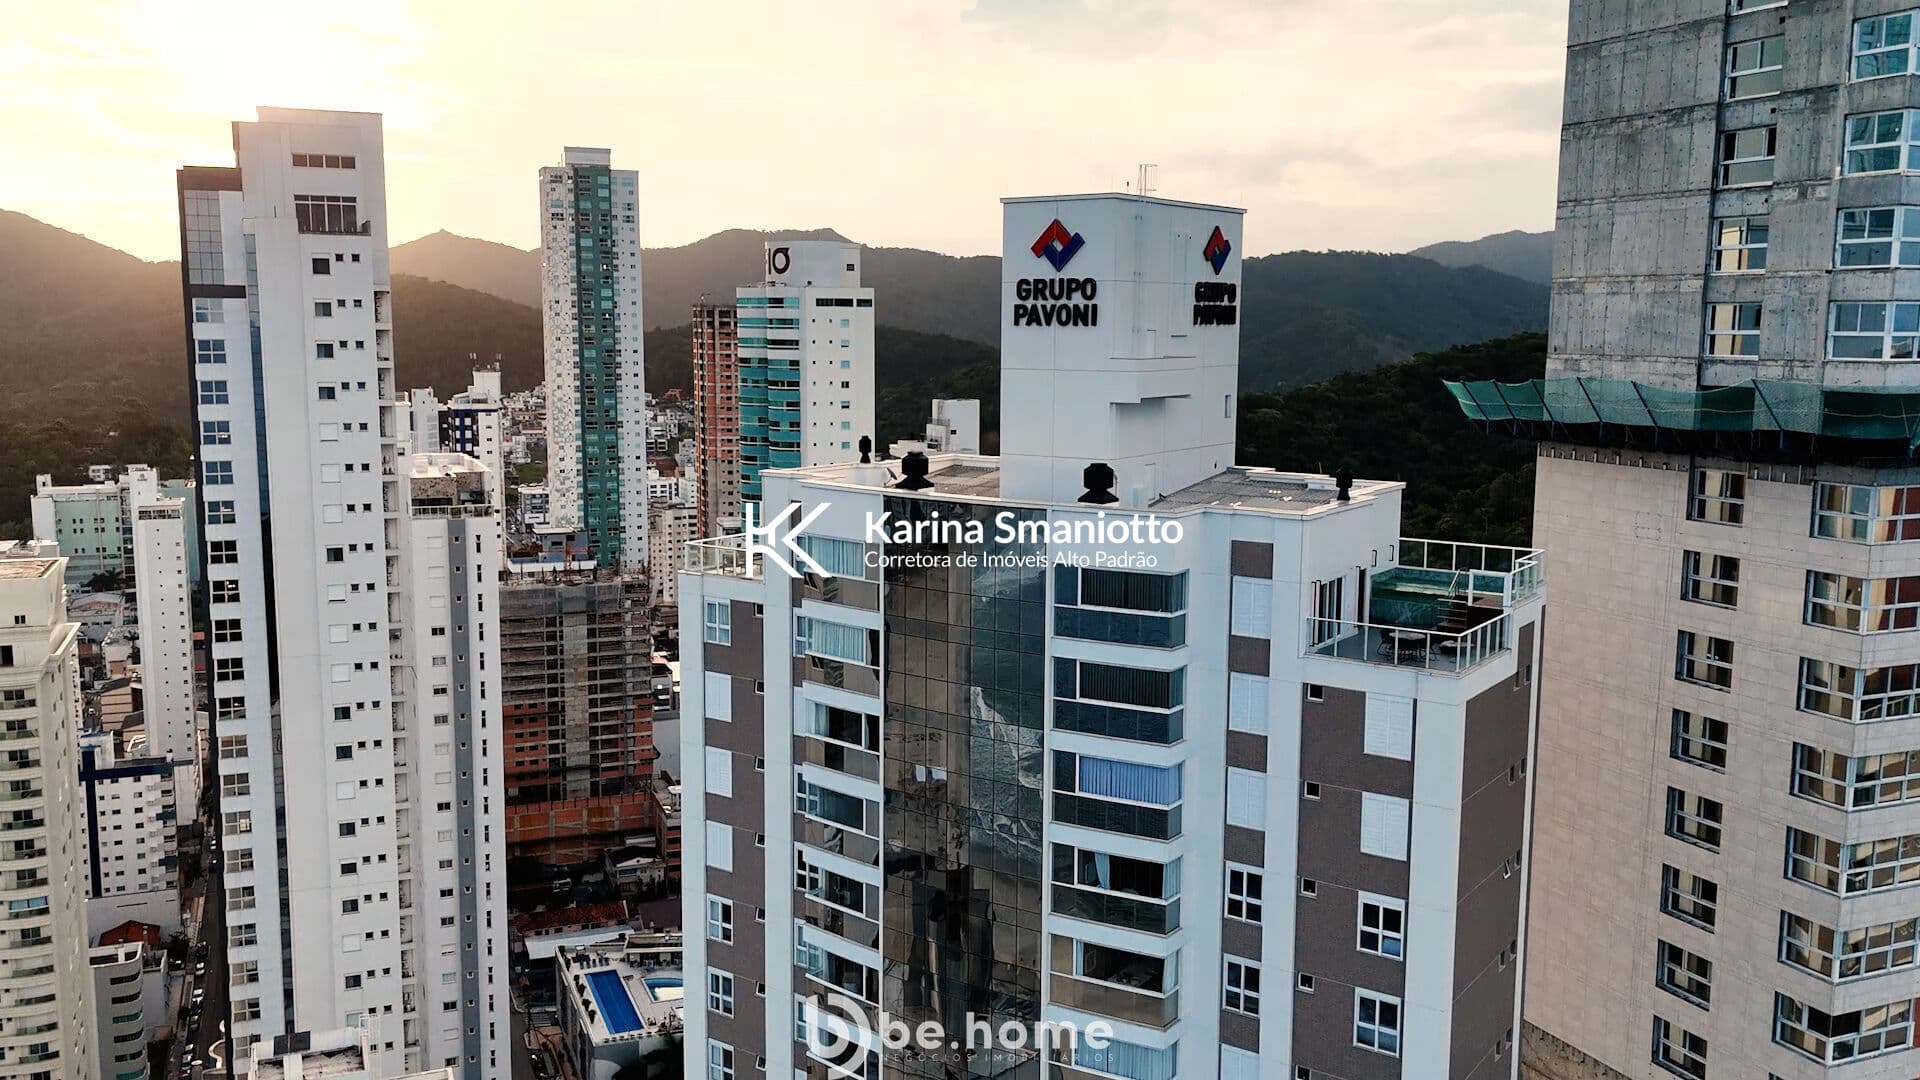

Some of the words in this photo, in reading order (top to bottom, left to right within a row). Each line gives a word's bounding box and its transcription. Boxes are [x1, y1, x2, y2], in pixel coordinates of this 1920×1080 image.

[1016, 278, 1097, 301] GRUPO
[1195, 281, 1236, 304] GPO
[1013, 304, 1098, 326] PAVONI
